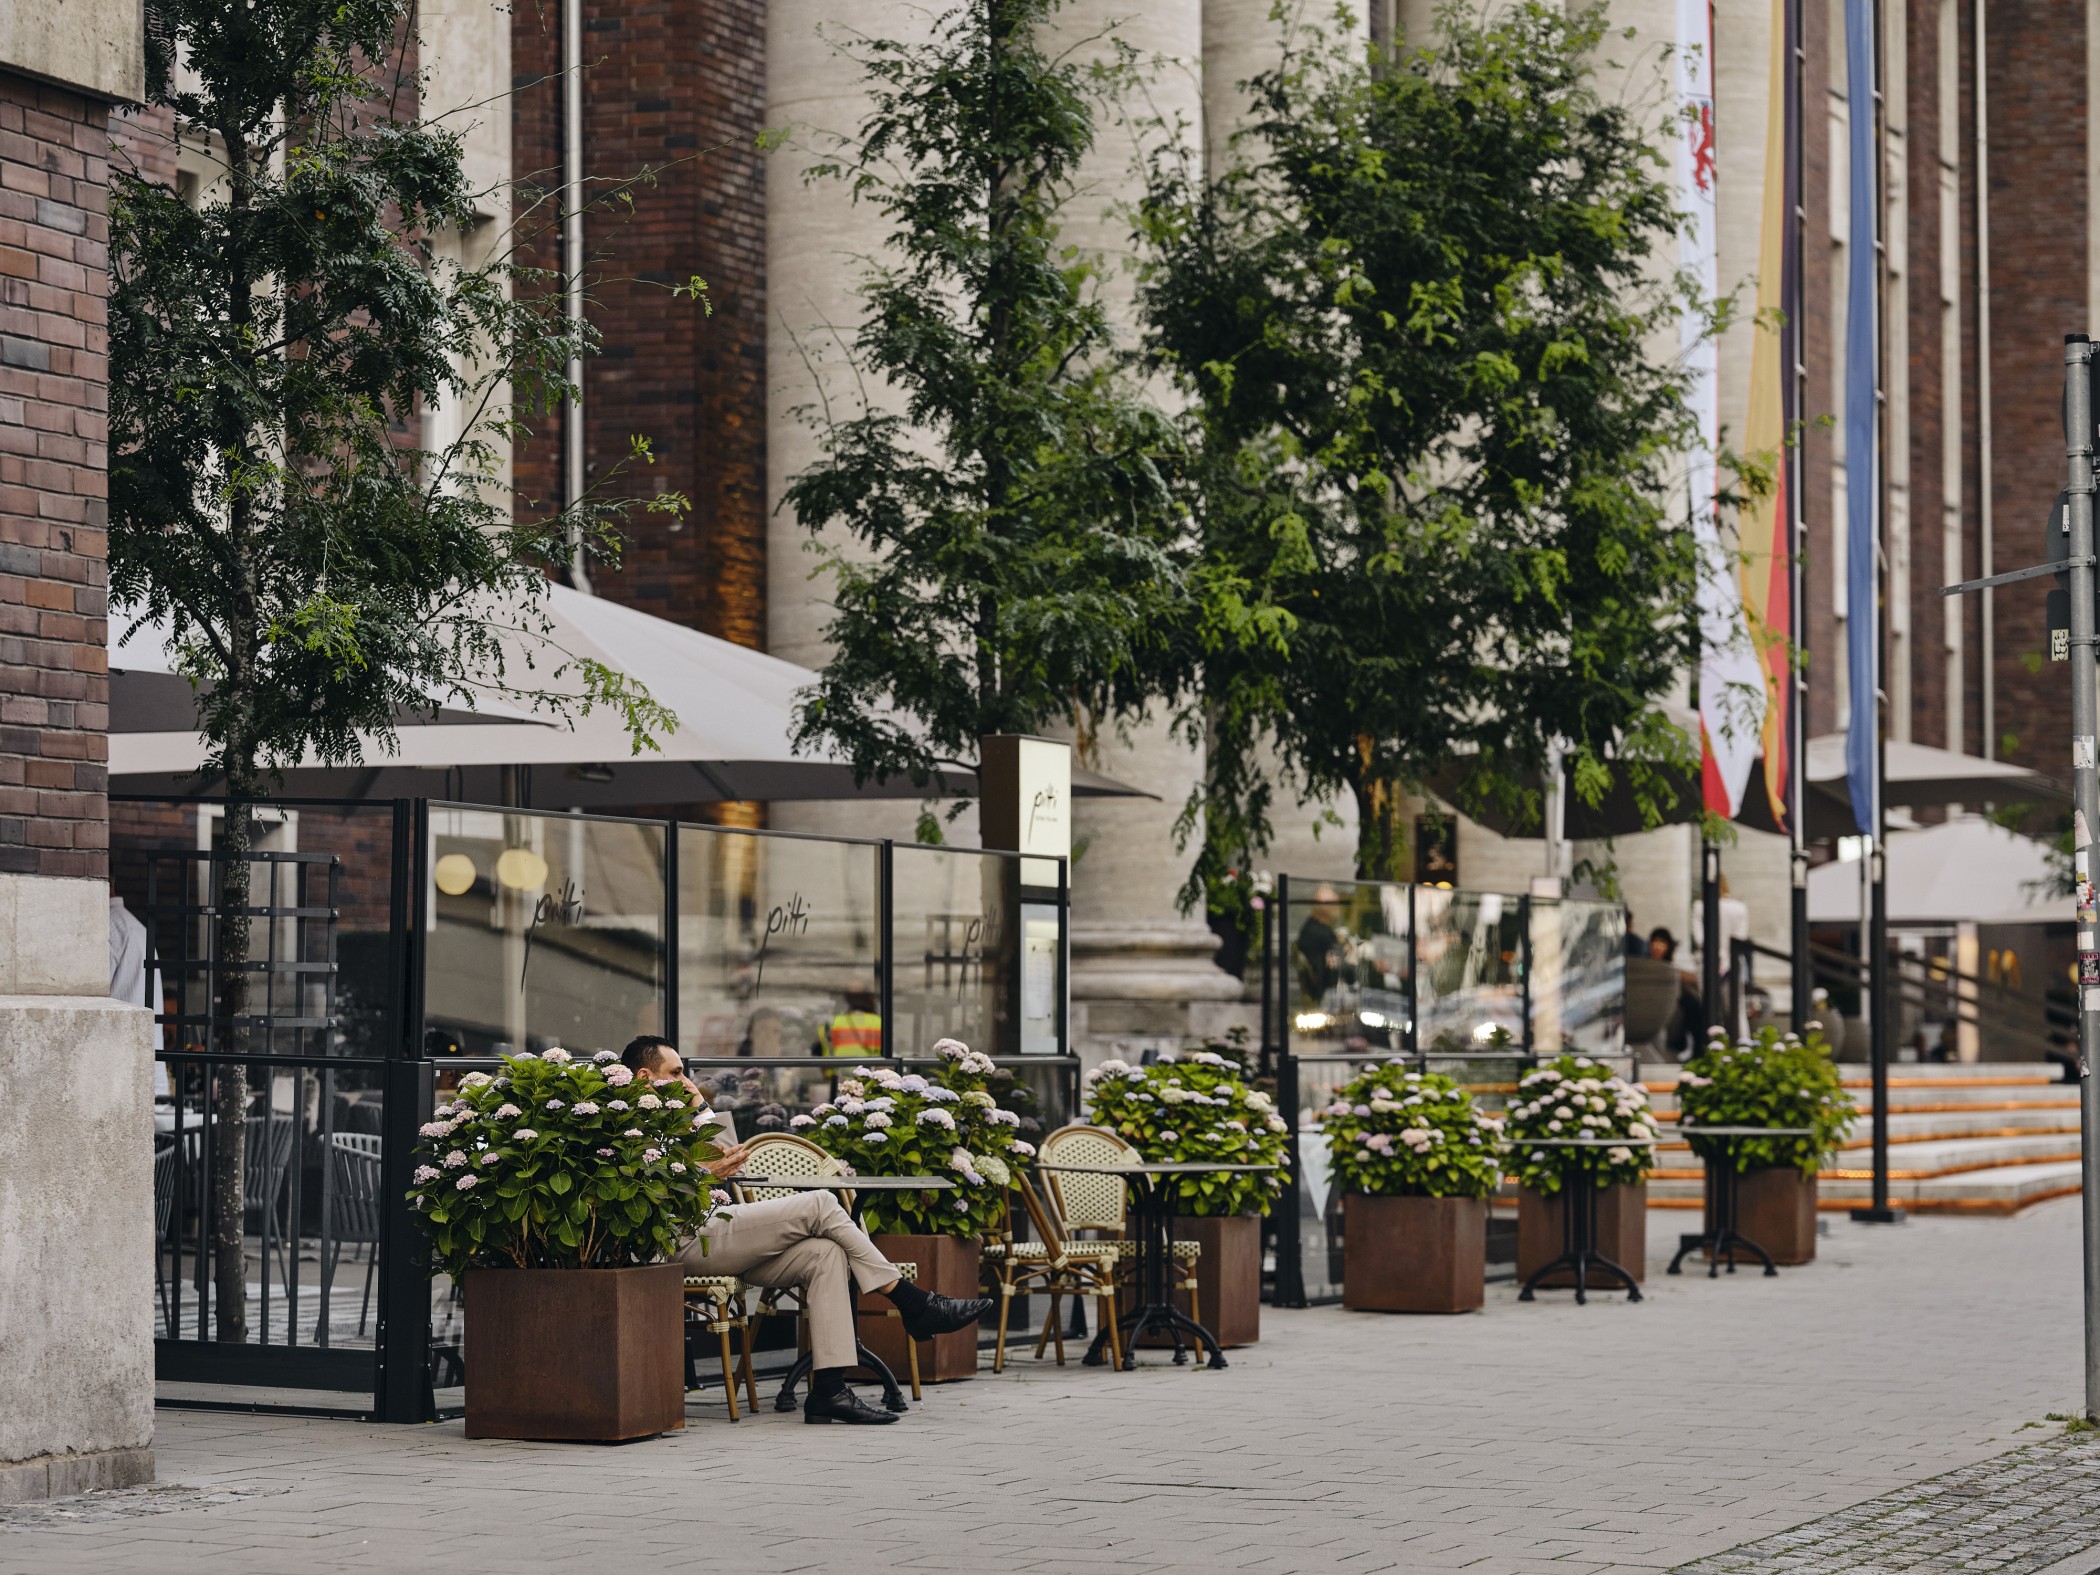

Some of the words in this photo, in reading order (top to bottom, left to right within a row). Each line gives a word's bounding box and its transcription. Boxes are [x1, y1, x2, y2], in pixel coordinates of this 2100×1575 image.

[1027, 782, 1059, 846] pitti
[521, 876, 586, 994] pitti
[756, 888, 810, 999] pitti
